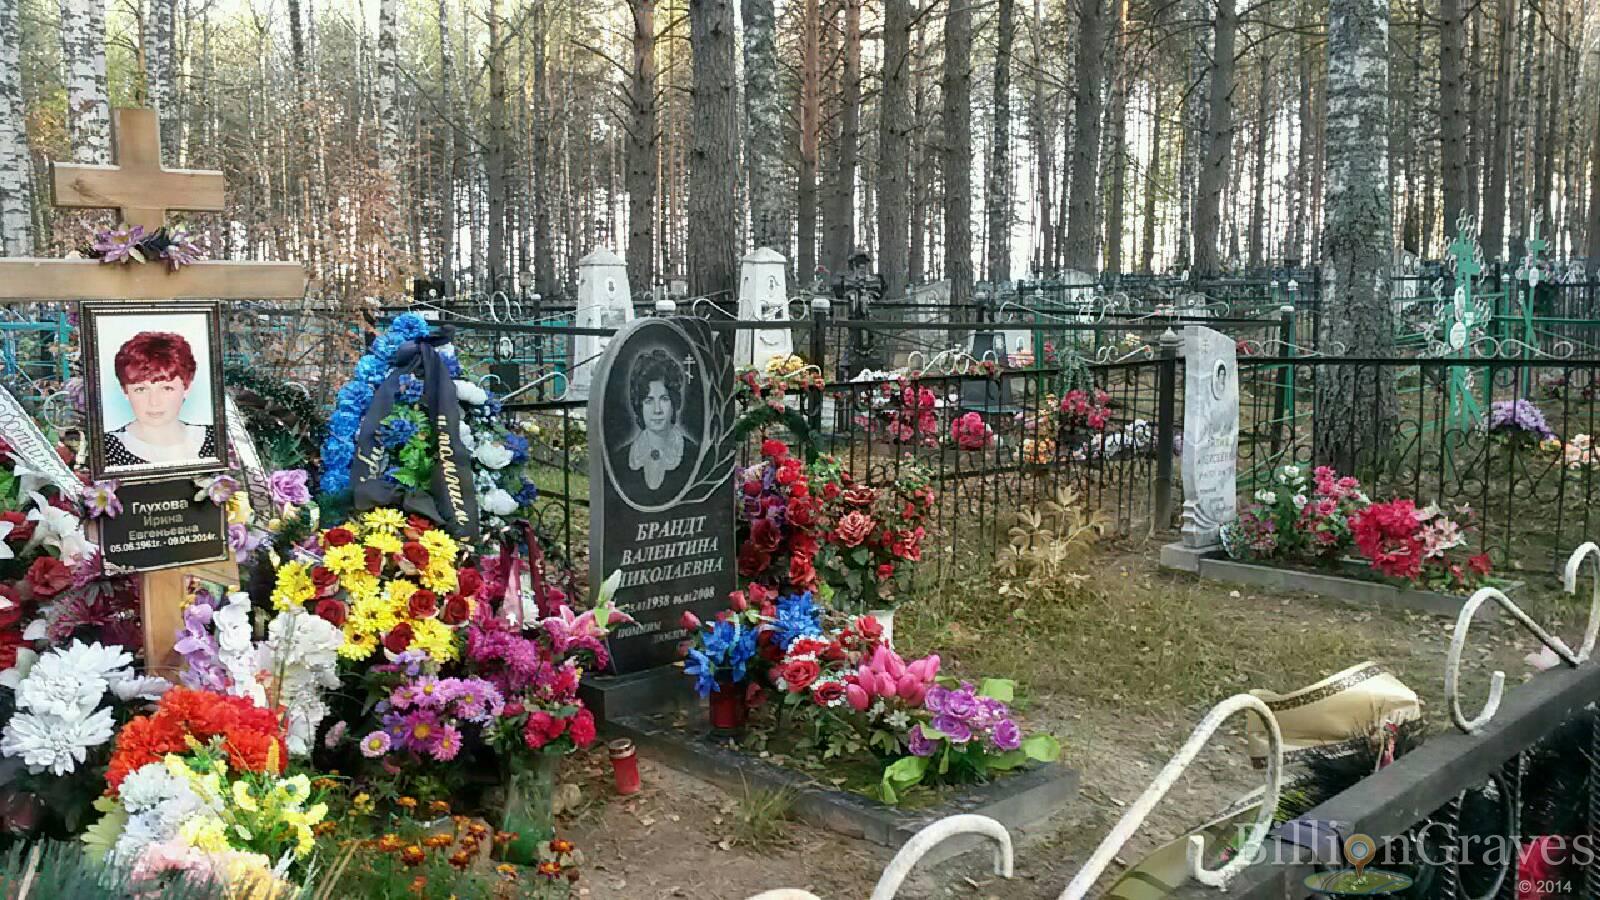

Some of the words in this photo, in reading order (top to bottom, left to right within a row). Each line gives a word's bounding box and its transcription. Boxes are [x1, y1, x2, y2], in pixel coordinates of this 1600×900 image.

[132, 499, 189, 515] Глухова
[143, 514, 184, 527] Ирина
[635, 516, 707, 542] БРАНДТ
[128, 524, 199, 541] Евгеньевна
[620, 536, 719, 566] ВАЛЕНТИНА
